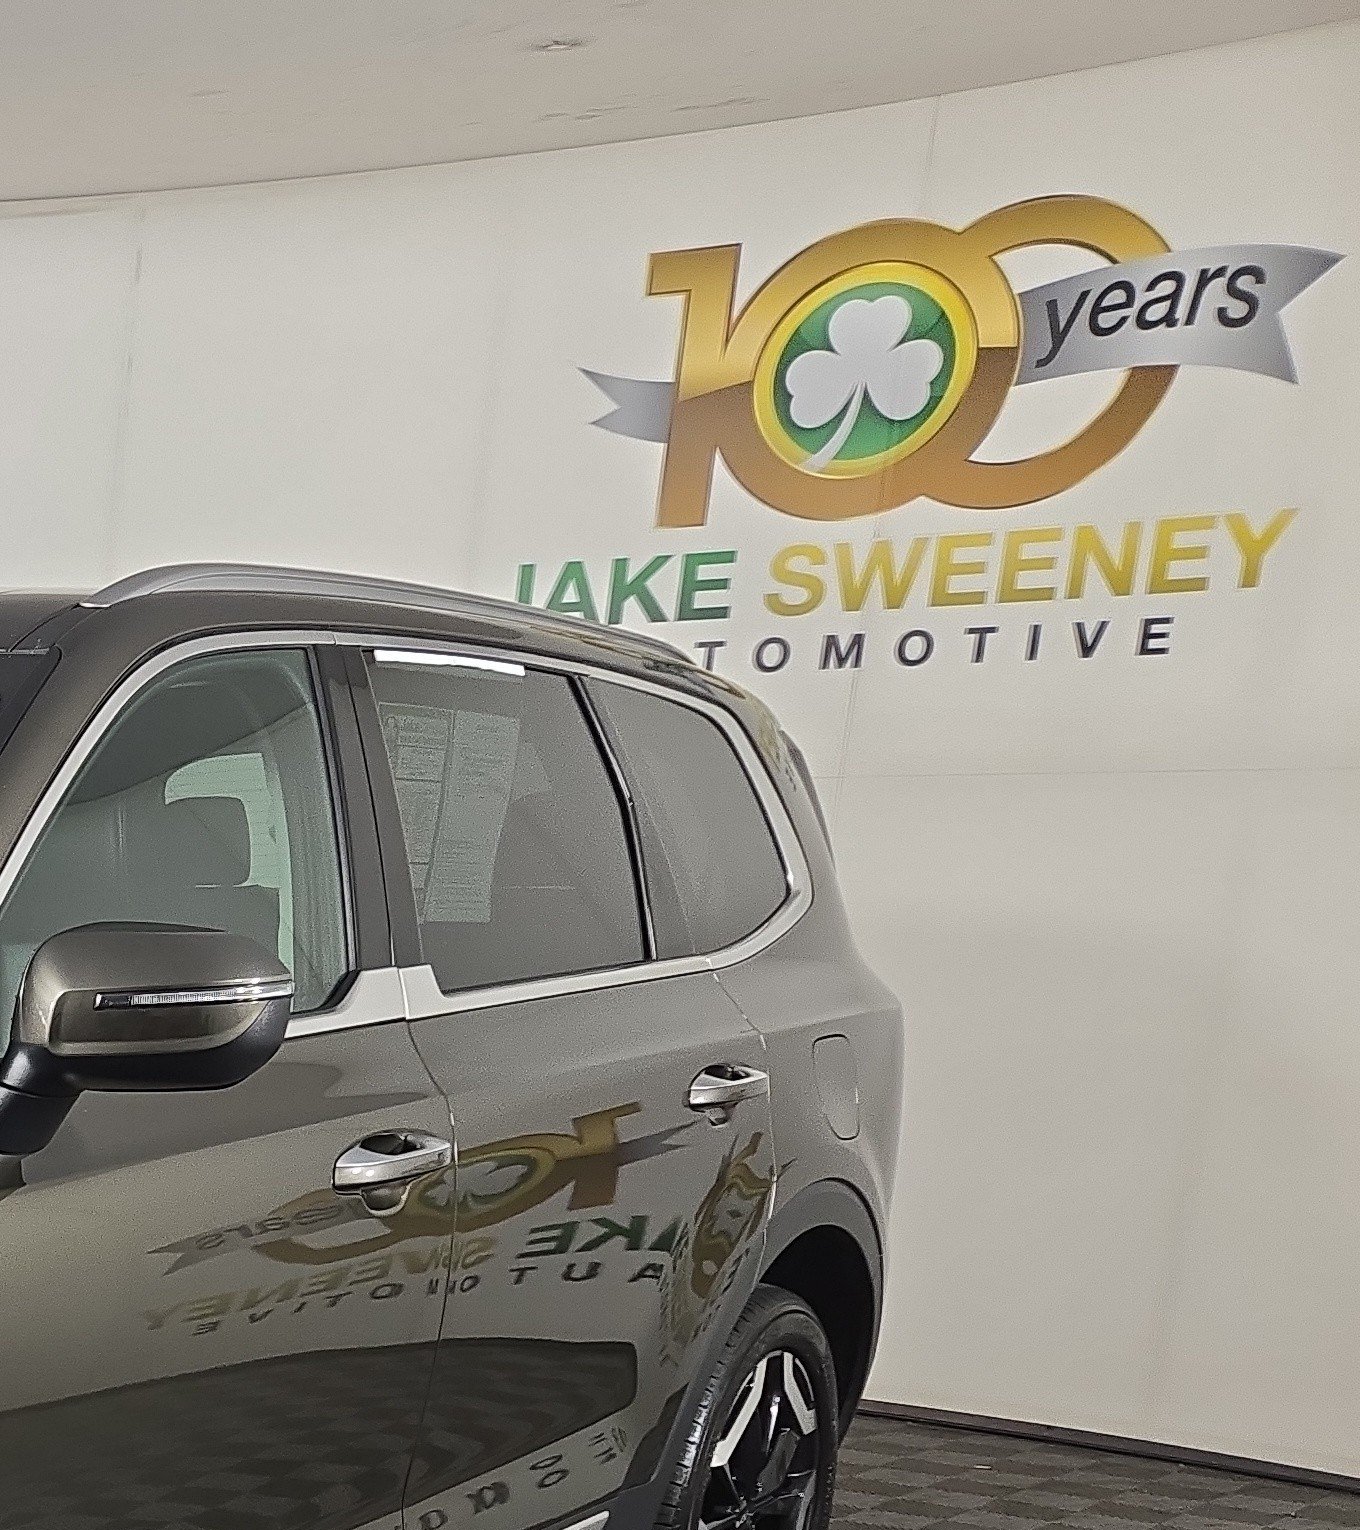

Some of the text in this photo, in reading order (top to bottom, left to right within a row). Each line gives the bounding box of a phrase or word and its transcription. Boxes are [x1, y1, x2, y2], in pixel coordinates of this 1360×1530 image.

[646, 194, 1180, 528] 100
[1034, 263, 1266, 369] years
[763, 508, 1297, 617] SWEENEY
[694, 617, 1173, 673] TOMOTIVE
